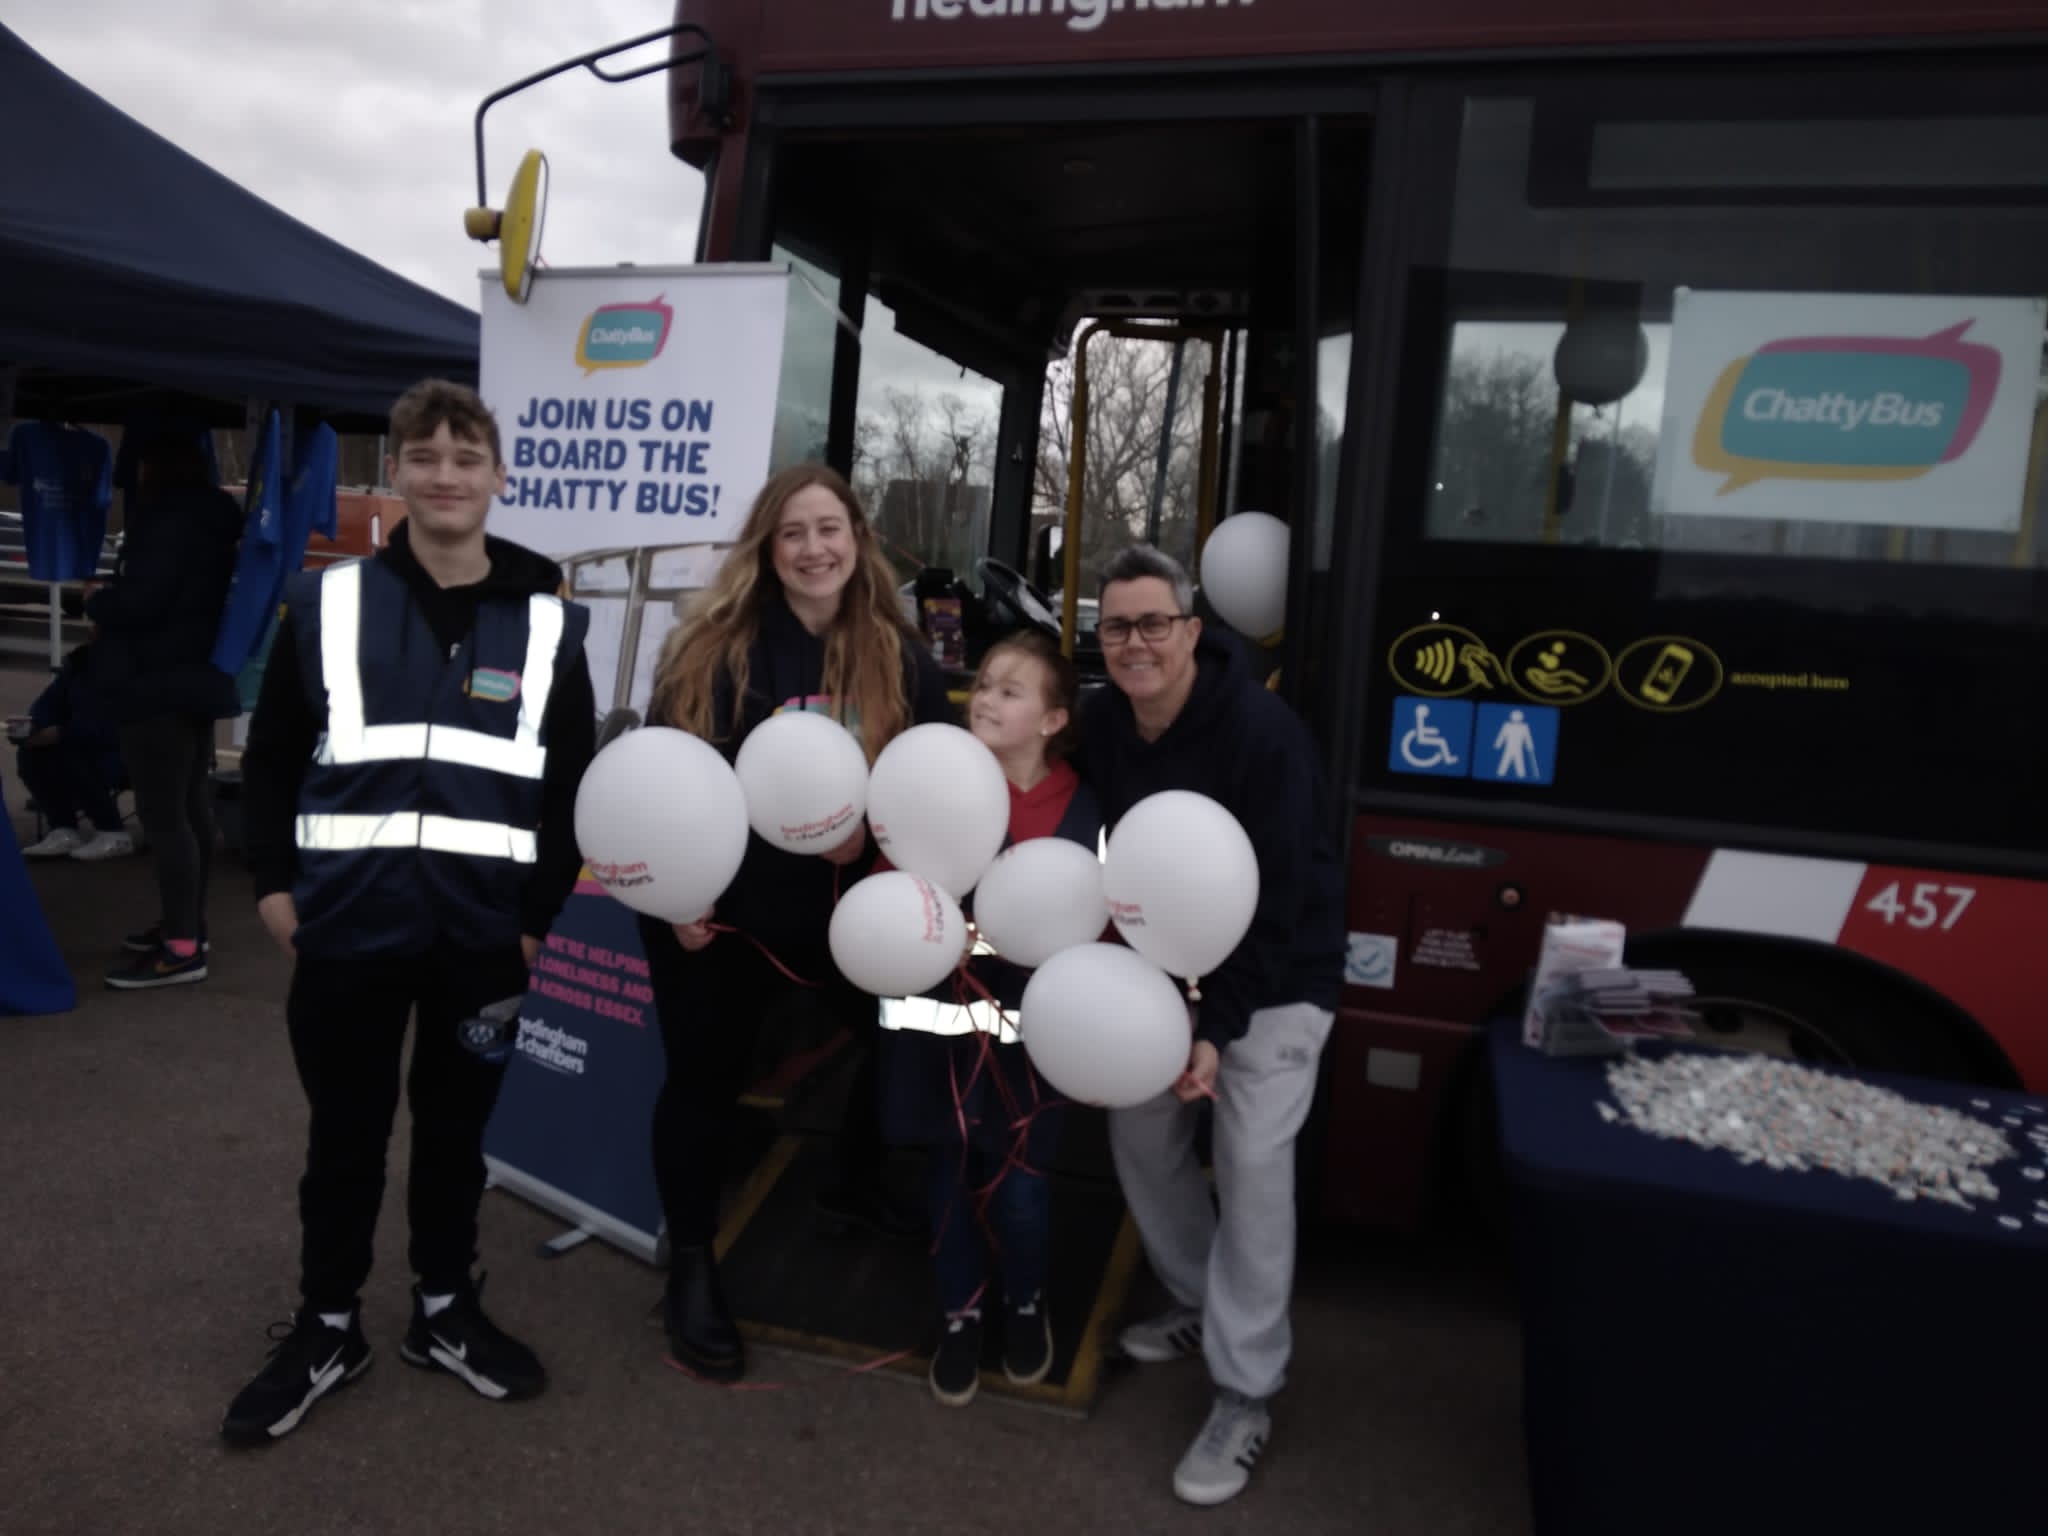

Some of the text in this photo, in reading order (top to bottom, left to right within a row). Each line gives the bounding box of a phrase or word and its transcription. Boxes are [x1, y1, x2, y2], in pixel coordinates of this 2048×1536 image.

[518, 399, 713, 432] JOIN US ON
[1743, 387, 1944, 430] ChattyBus
[514, 438, 710, 474] BOARD THE
[500, 477, 720, 517] CHATTY BUS!
[1731, 672, 1850, 692] accepted here
[1865, 880, 1976, 931] 457
[539, 954, 620, 992] LONELINESS
[622, 981, 654, 1004] AND
[588, 947, 650, 977] HELPING
